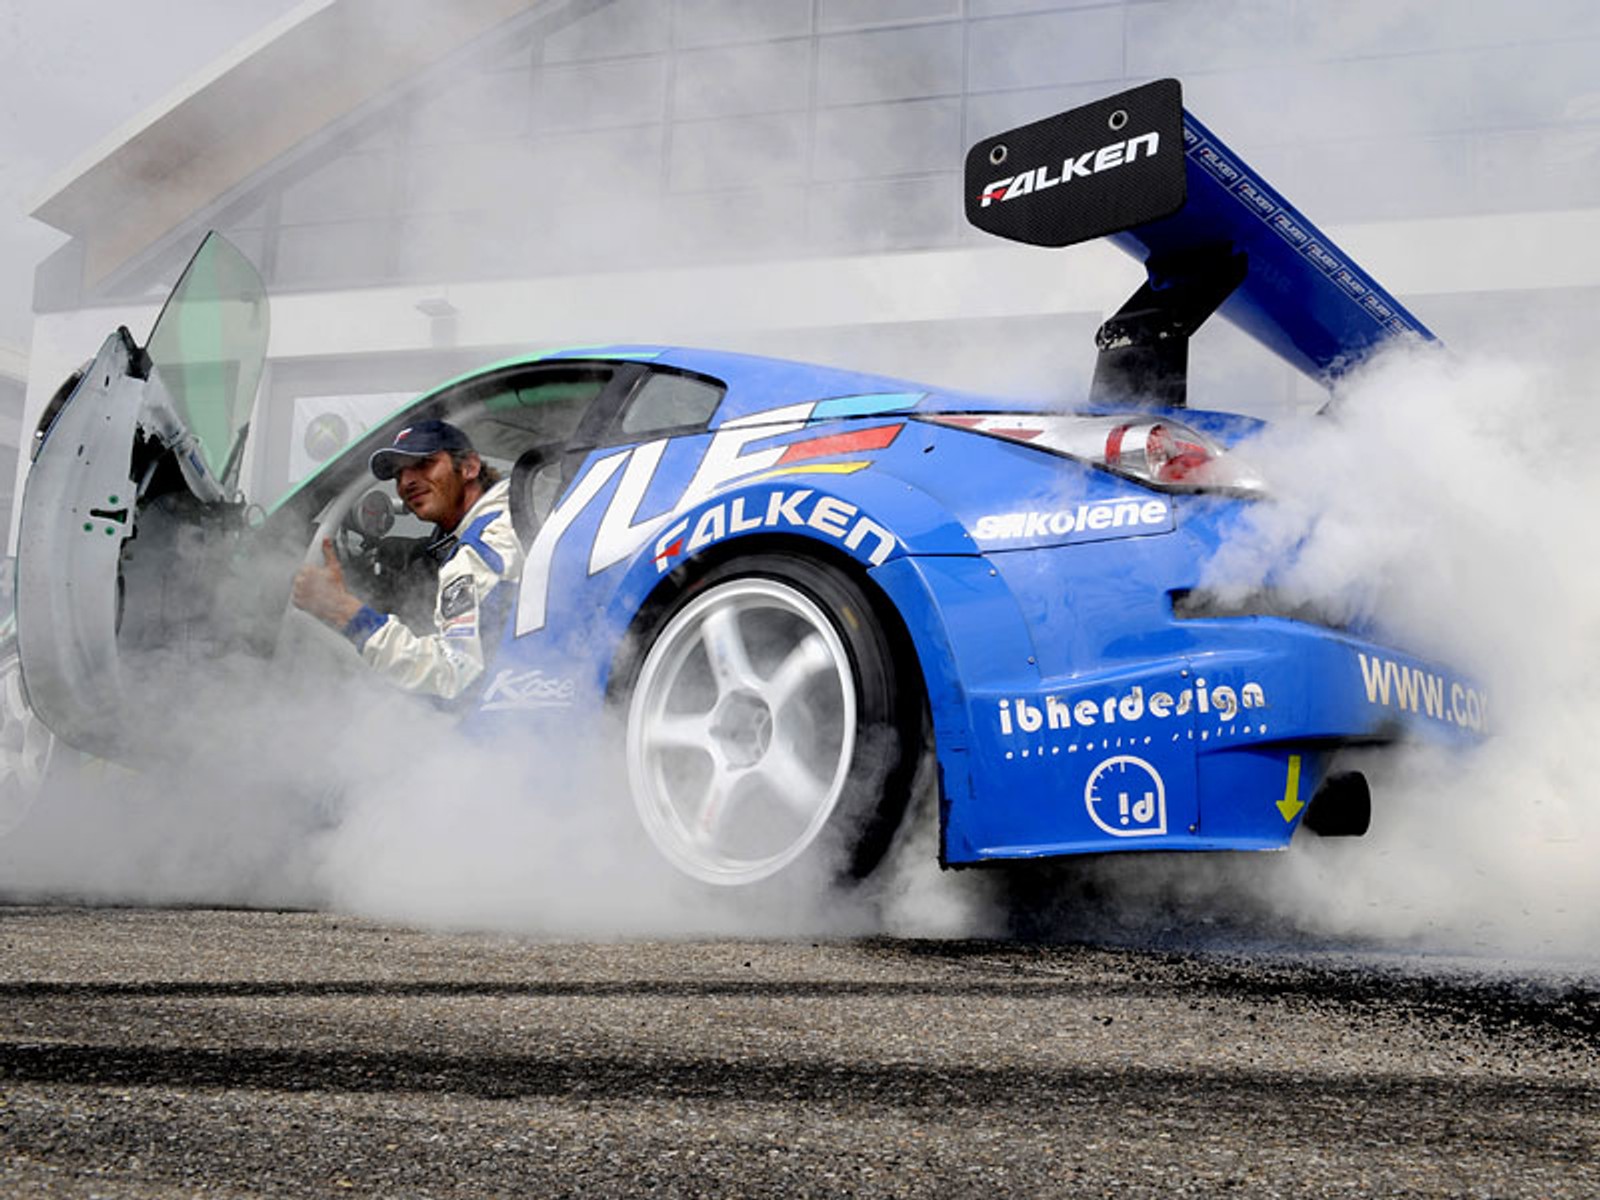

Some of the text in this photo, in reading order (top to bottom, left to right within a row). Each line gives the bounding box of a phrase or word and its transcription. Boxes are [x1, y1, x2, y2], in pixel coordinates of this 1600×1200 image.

[976, 131, 1160, 208] FALKEN
[650, 489, 896, 574] FALKEN
[999, 677, 1267, 735] ibherdesign
